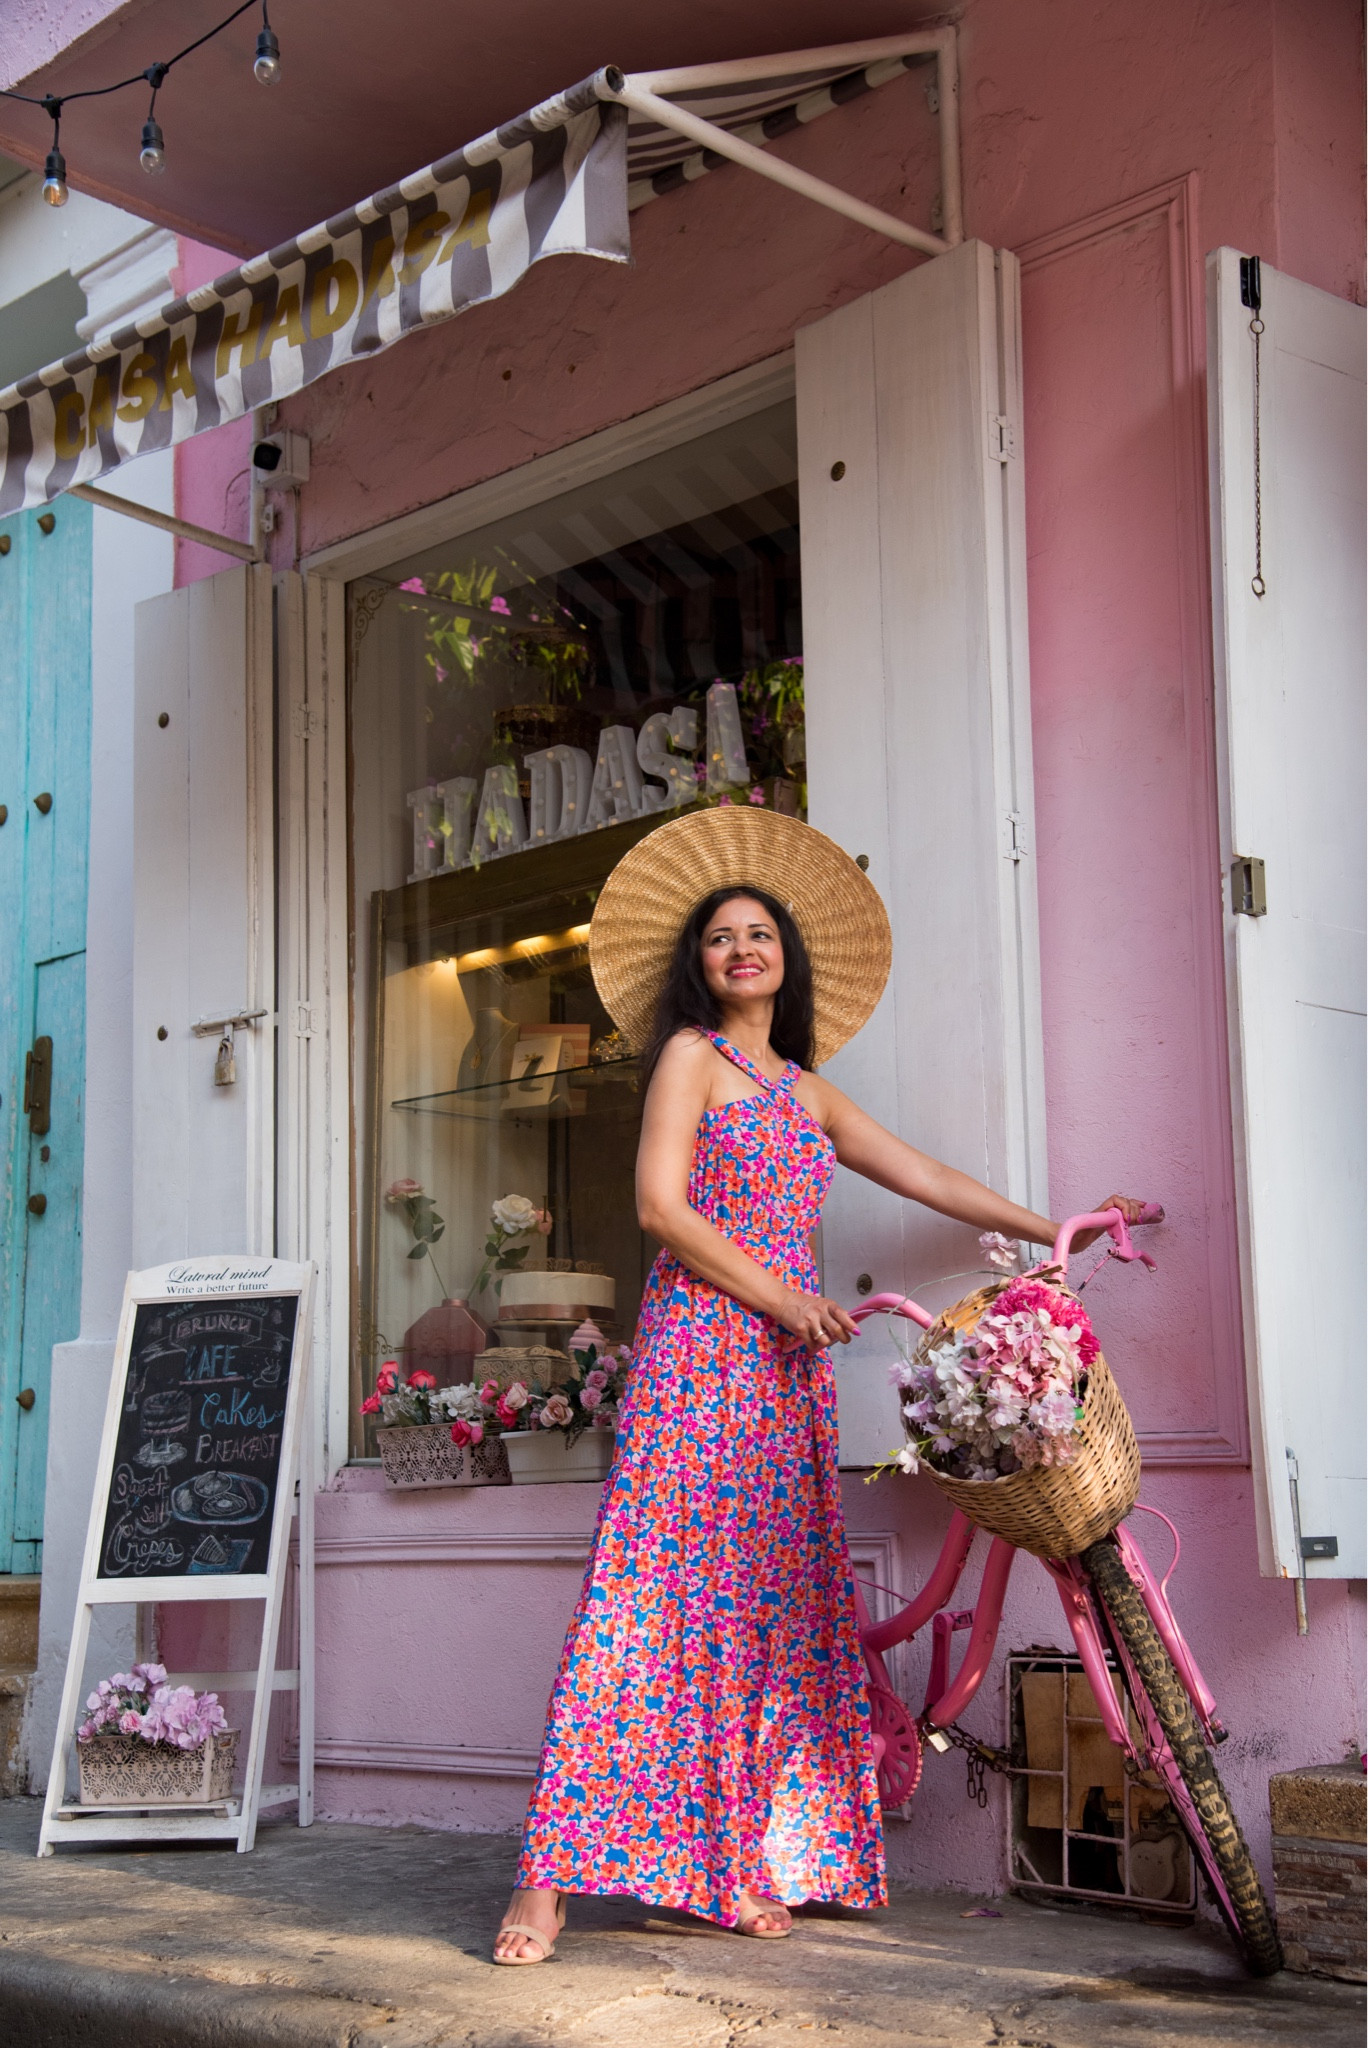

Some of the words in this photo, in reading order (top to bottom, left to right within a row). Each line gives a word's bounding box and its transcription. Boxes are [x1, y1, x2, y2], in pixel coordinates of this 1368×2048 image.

[54, 334, 196, 461] CASA
[216, 190, 493, 379] HADASA
[406, 682, 751, 884] HADASA
[229, 1265, 273, 1280] mind
[166, 1285, 194, 1294] Write
[206, 1284, 235, 1293] better
[238, 1282, 269, 1291] future
[176, 1314, 252, 1338] BRUNCH
[184, 1345, 241, 1380] CAFE
[195, 1433, 279, 1463] BREAKFAST
[118, 1472, 167, 1497] Sweet
